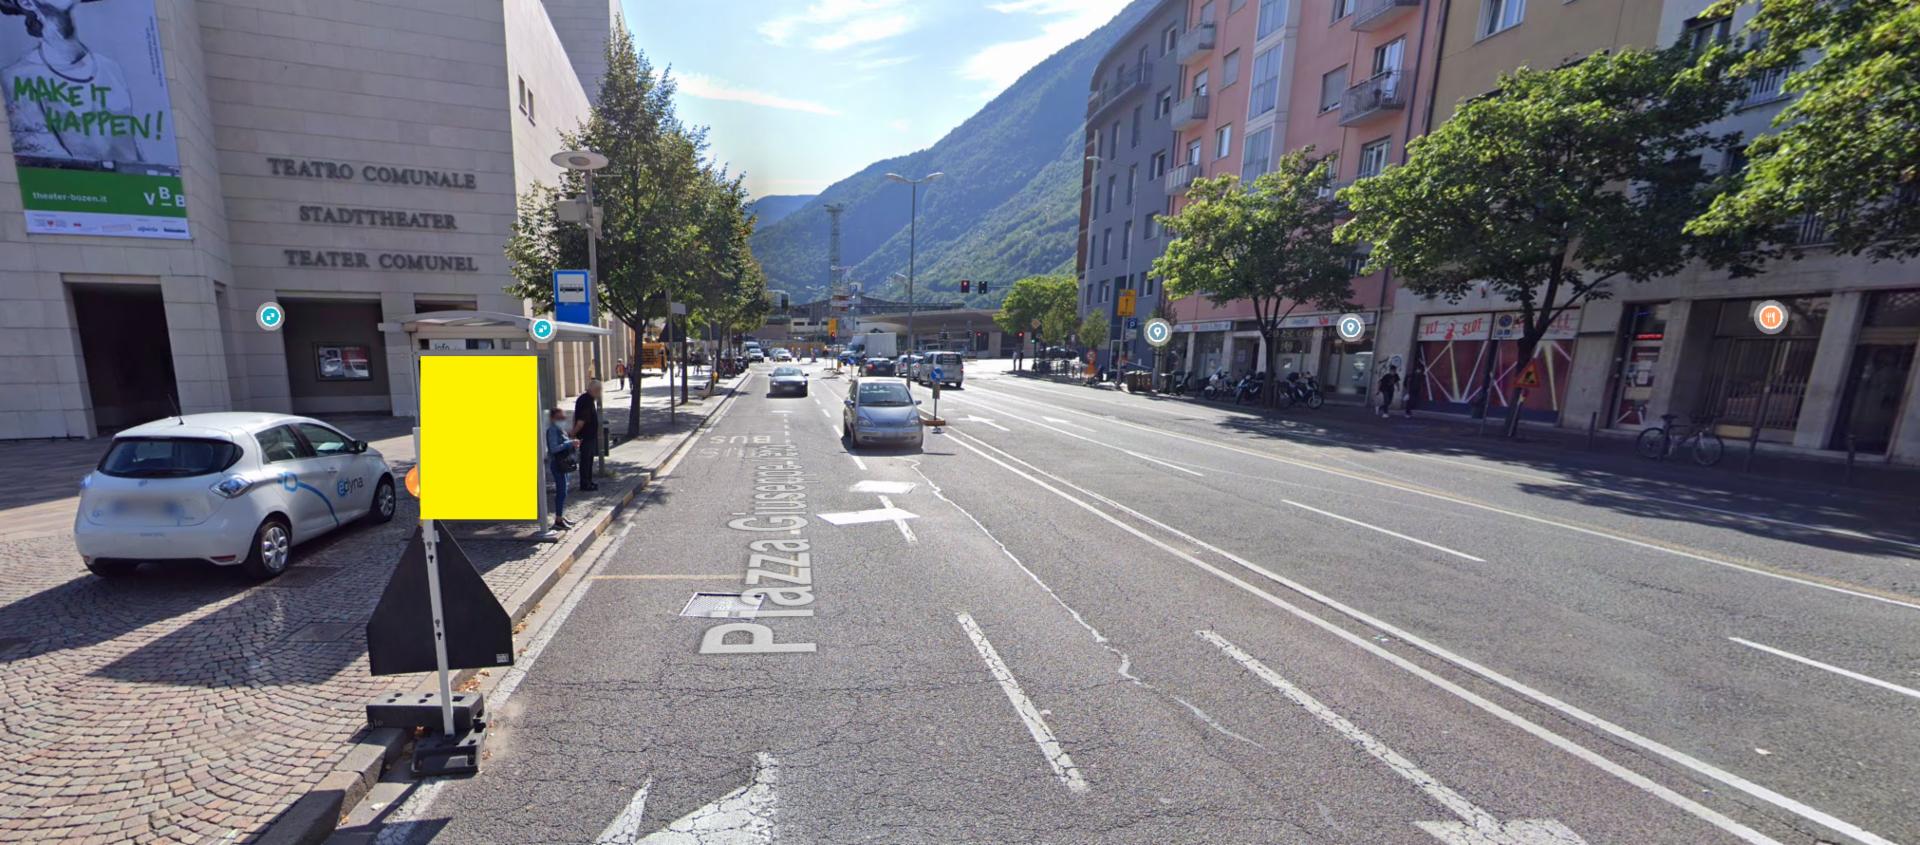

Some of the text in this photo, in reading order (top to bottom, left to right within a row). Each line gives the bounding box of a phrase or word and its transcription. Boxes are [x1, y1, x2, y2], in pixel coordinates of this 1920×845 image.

[14, 76, 112, 108] MAKE IT
[45, 111, 164, 141] HAPPEN!
[267, 158, 477, 190] TEATRO COMUNALE
[32, 191, 109, 204] theater-bozen.it
[299, 205, 458, 230] STADTTHEATER
[284, 249, 478, 272] TEATER COMUNEL
[709, 434, 772, 445] BUS
